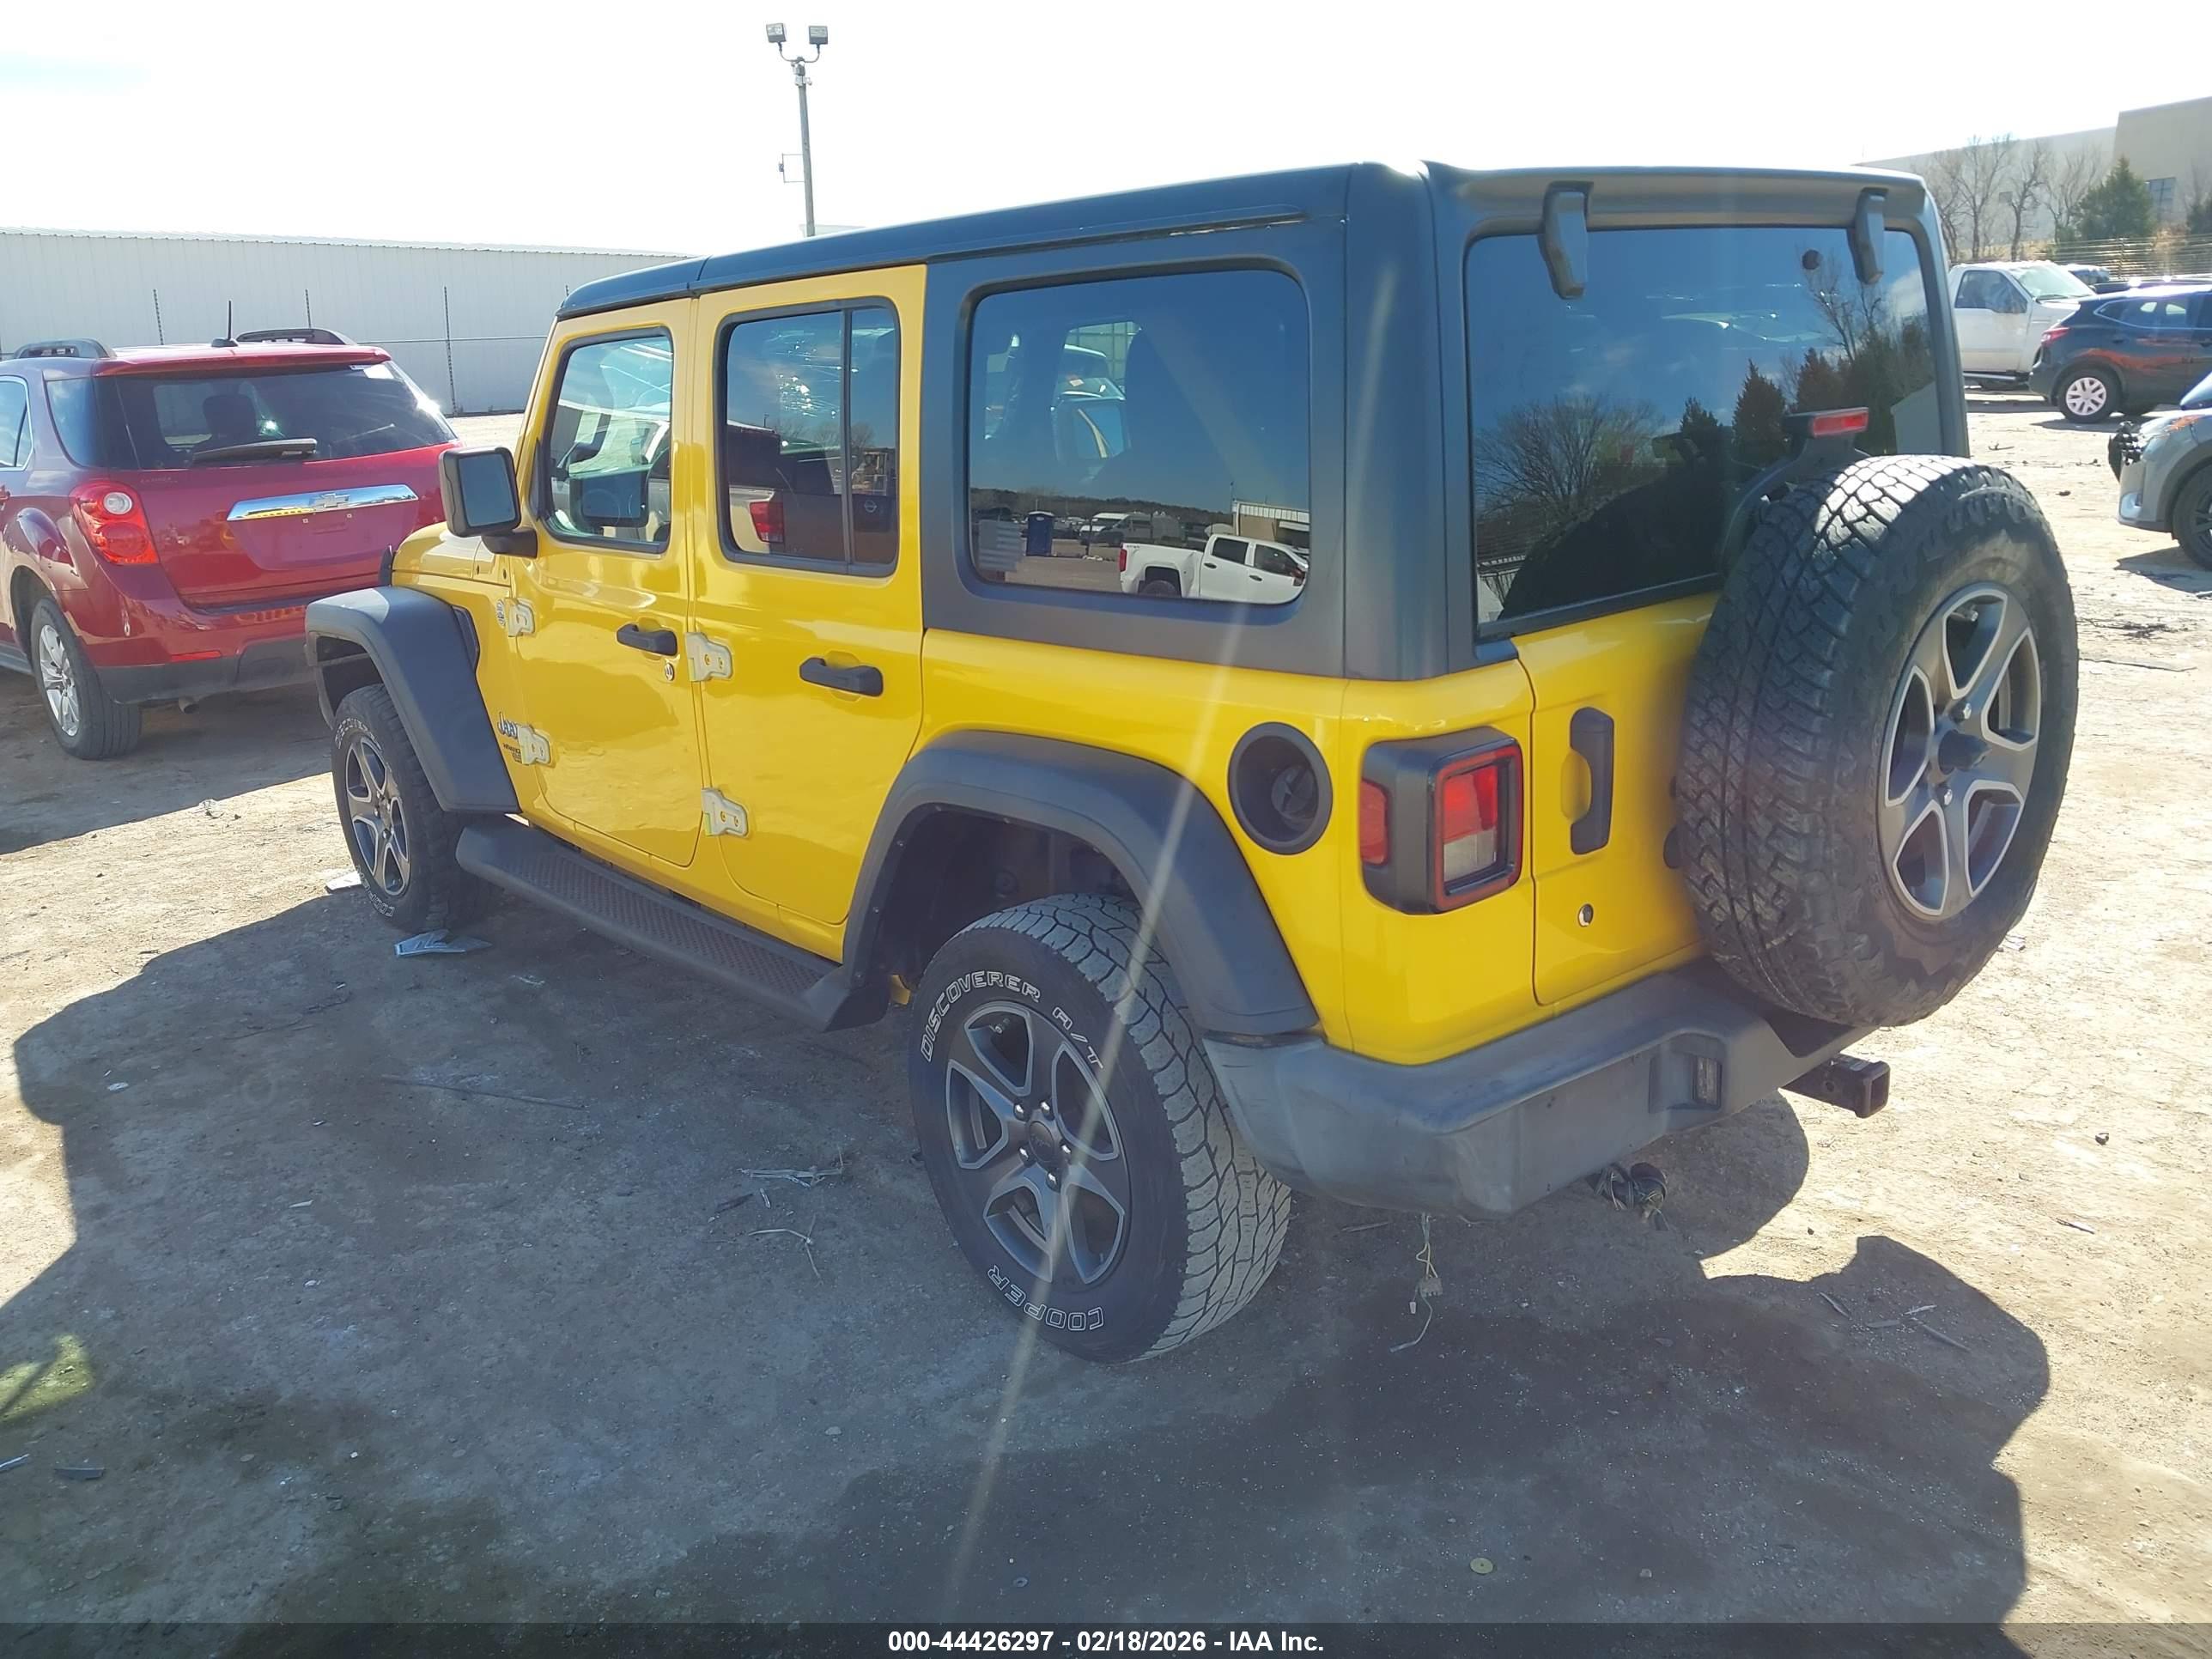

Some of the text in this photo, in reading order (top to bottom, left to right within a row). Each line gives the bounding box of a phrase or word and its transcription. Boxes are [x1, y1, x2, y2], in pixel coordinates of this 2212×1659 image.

[497, 711, 519, 738] Jee
[921, 970, 1103, 1069] DISCOVERER A/T
[988, 1265, 1104, 1331] COOPER
